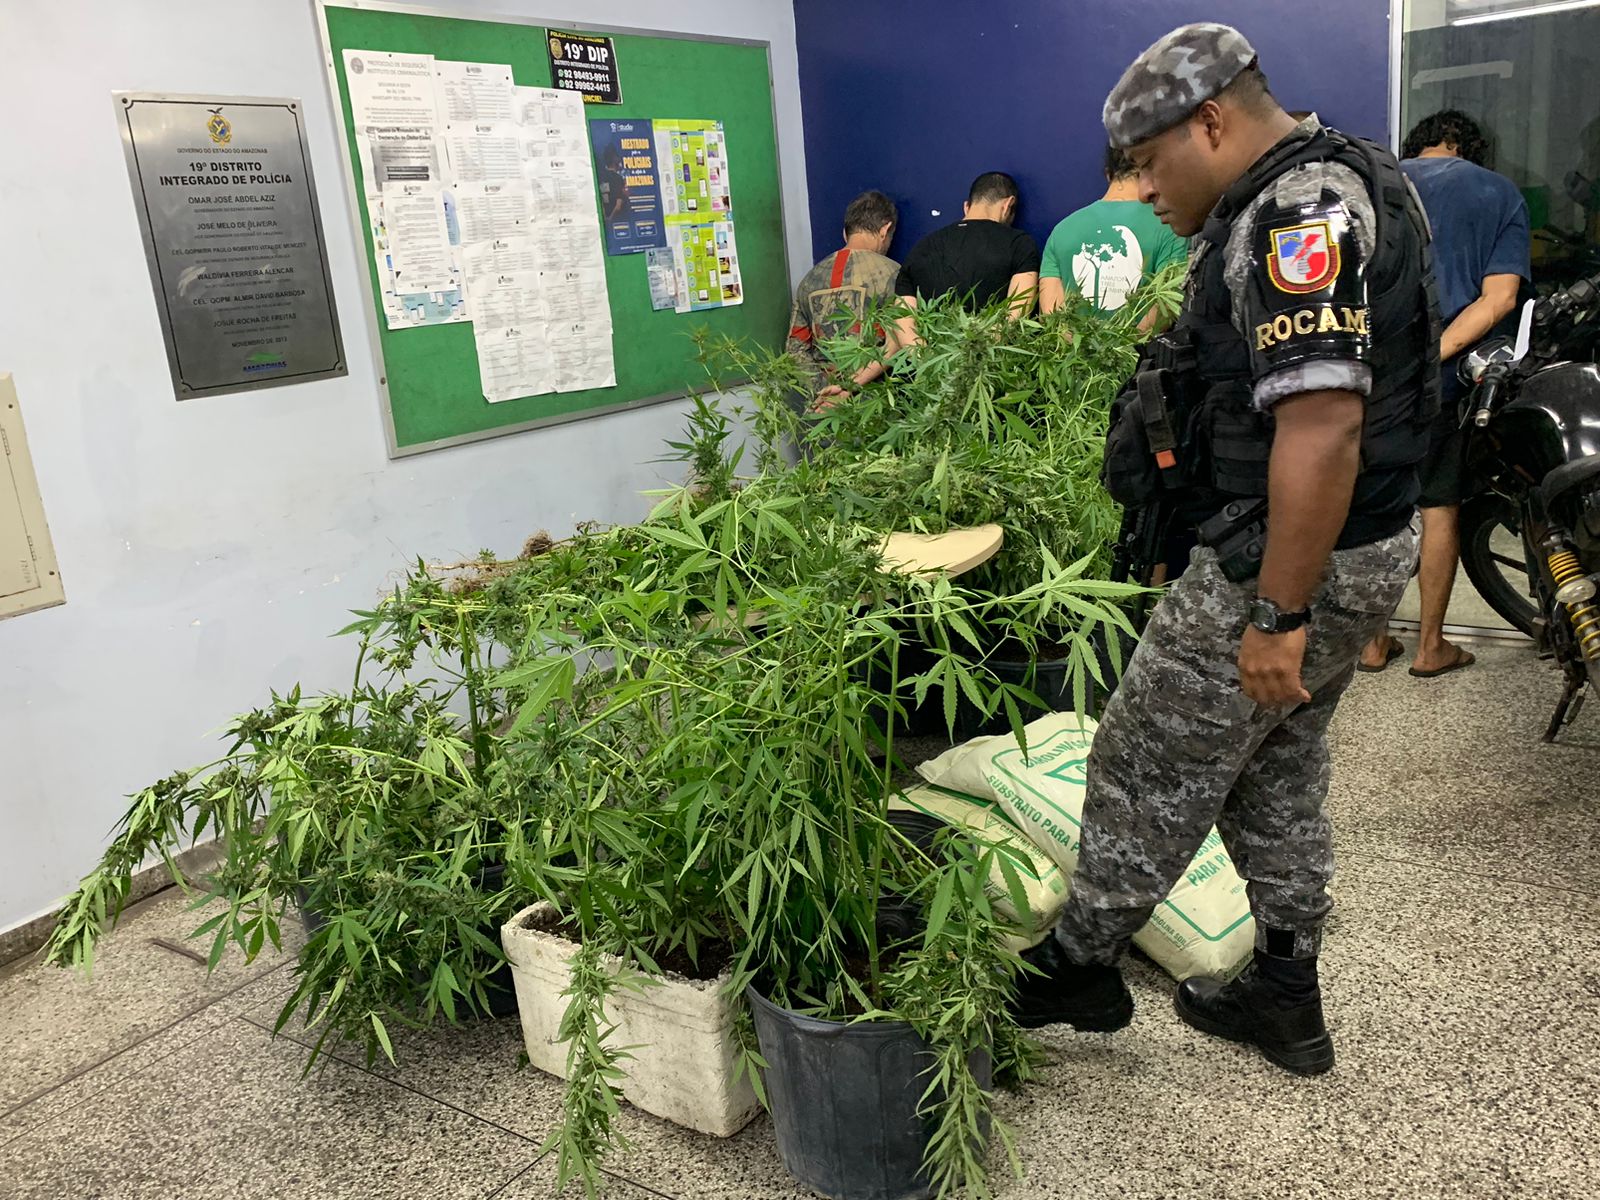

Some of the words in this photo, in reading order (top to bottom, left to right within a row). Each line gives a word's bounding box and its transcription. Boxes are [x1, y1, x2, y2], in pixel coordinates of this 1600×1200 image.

[587, 45, 609, 63] DIP
[564, 69, 573, 79] 92
[565, 79, 574, 89] 92
[210, 162, 263, 172] DISTRITO
[159, 175, 229, 186] INTEGRADO
[232, 175, 248, 185] DE
[250, 172, 293, 184] POLÍCIA
[188, 196, 212, 204] OMAR
[213, 195, 233, 204] JOSÉ
[235, 195, 260, 203] ABDEL
[260, 194, 276, 202] AZIZ
[216, 221, 237, 230] MELO
[236, 221, 246, 229] DE
[247, 220, 278, 230] OLIVEIRA
[232, 244, 259, 252] ROBERTO
[230, 268, 264, 278] FERREIRA
[264, 266, 294, 275] ALENCAR
[275, 289, 306, 298] BARBOSA
[236, 317, 260, 325] ROCHA
[270, 312, 297, 321] FREITAS
[1254, 306, 1368, 351] ROCAM
[231, 338, 265, 348] NOVEMBRO
[987, 775, 1043, 824] SUBSTRATO
[1042, 817, 1071, 847] PARA
[999, 824, 1032, 850] CAROLINA
[1031, 845, 1046, 860] SOIL
[1186, 860, 1221, 887] PARA
